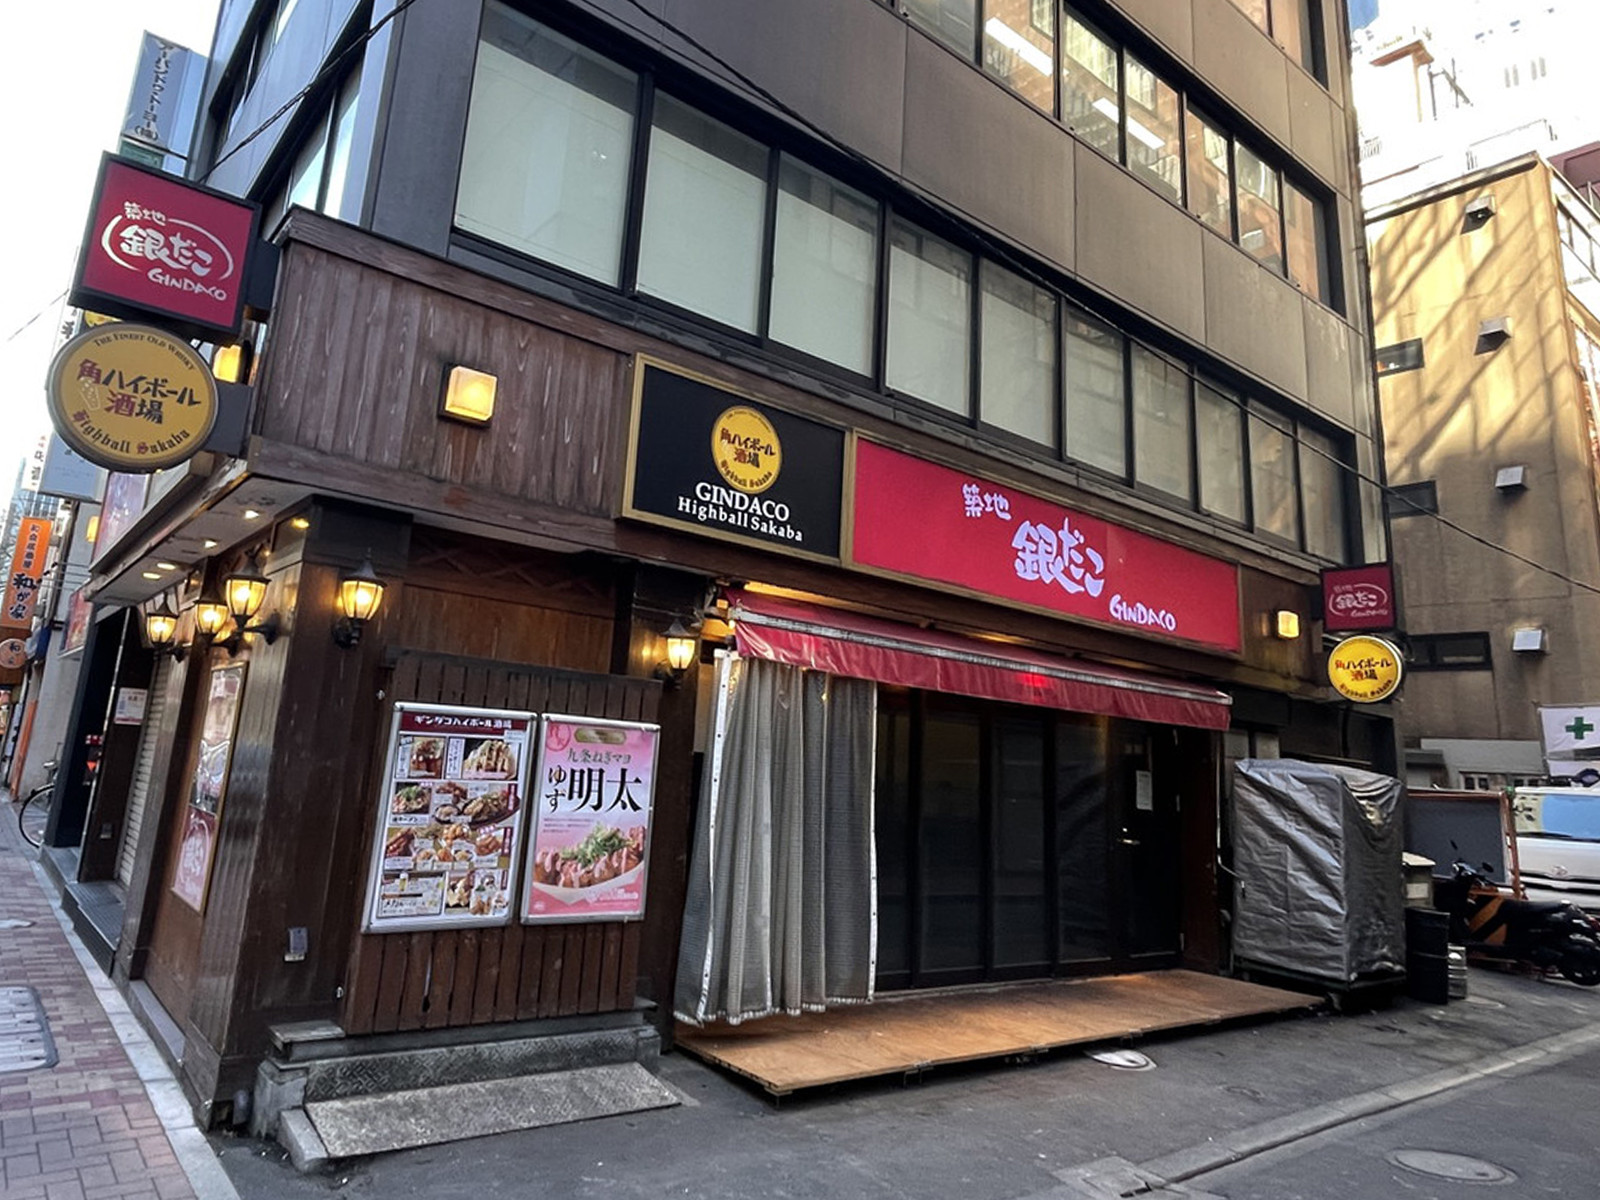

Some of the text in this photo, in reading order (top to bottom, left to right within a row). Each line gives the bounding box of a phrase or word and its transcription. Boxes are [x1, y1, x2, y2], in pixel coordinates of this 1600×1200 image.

[124, 201, 166, 227] 築地
[119, 224, 213, 277] 銀だこ
[147, 268, 227, 301] GINDACO
[76, 358, 202, 407] 角ハイボール
[104, 390, 164, 425] 酒場
[72, 408, 191, 455] Highball Sakaba
[720, 427, 776, 456] 角ハイボール
[734, 446, 760, 469] 酒場
[677, 496, 803, 542] Highball Sakaba
[695, 481, 790, 522] GINDACO
[962, 483, 1012, 521] 築地
[1011, 517, 1105, 598] 銀だこ
[1109, 594, 1177, 631] GINDACO
[1335, 657, 1393, 670] 角ハイボール
[1350, 668, 1378, 682] 酒場
[567, 747, 632, 765] 九条ねぎマヨ
[544, 764, 567, 813] ゆず
[567, 766, 643, 813] 明太
